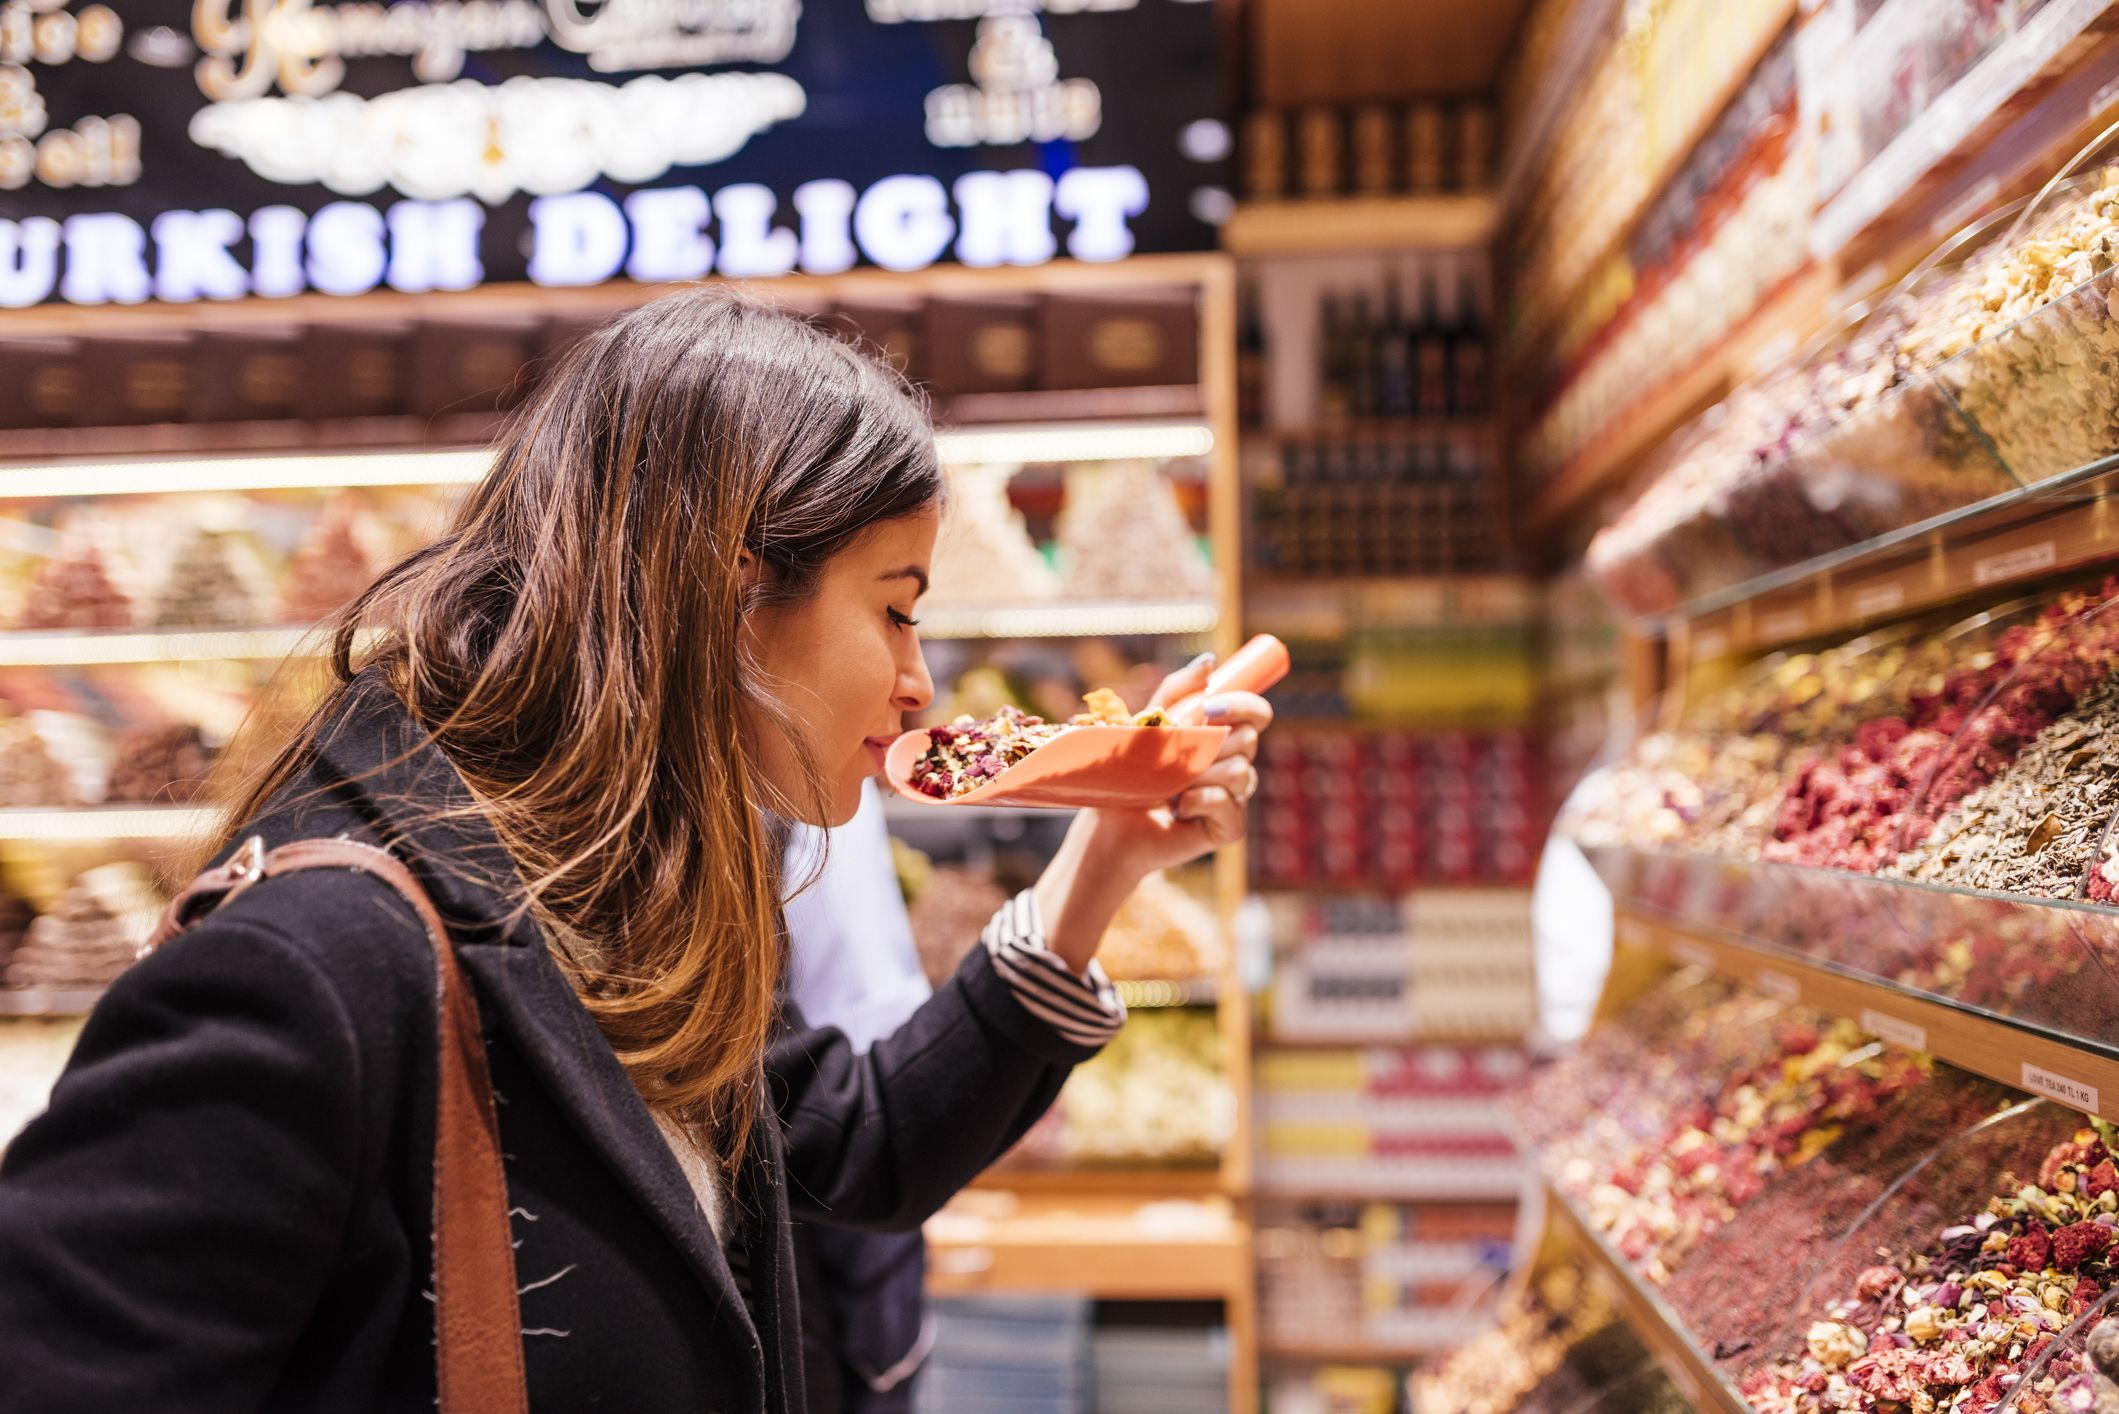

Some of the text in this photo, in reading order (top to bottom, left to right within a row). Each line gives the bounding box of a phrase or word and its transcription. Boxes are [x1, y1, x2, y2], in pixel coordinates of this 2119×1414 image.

[527, 165, 1149, 286] DELIGHT
[2028, 1072, 2044, 1087] LOVE
[2044, 1078, 2056, 1092] TEA
[2067, 1086, 2075, 1098] TL
[2080, 1090, 2090, 1103] KG
